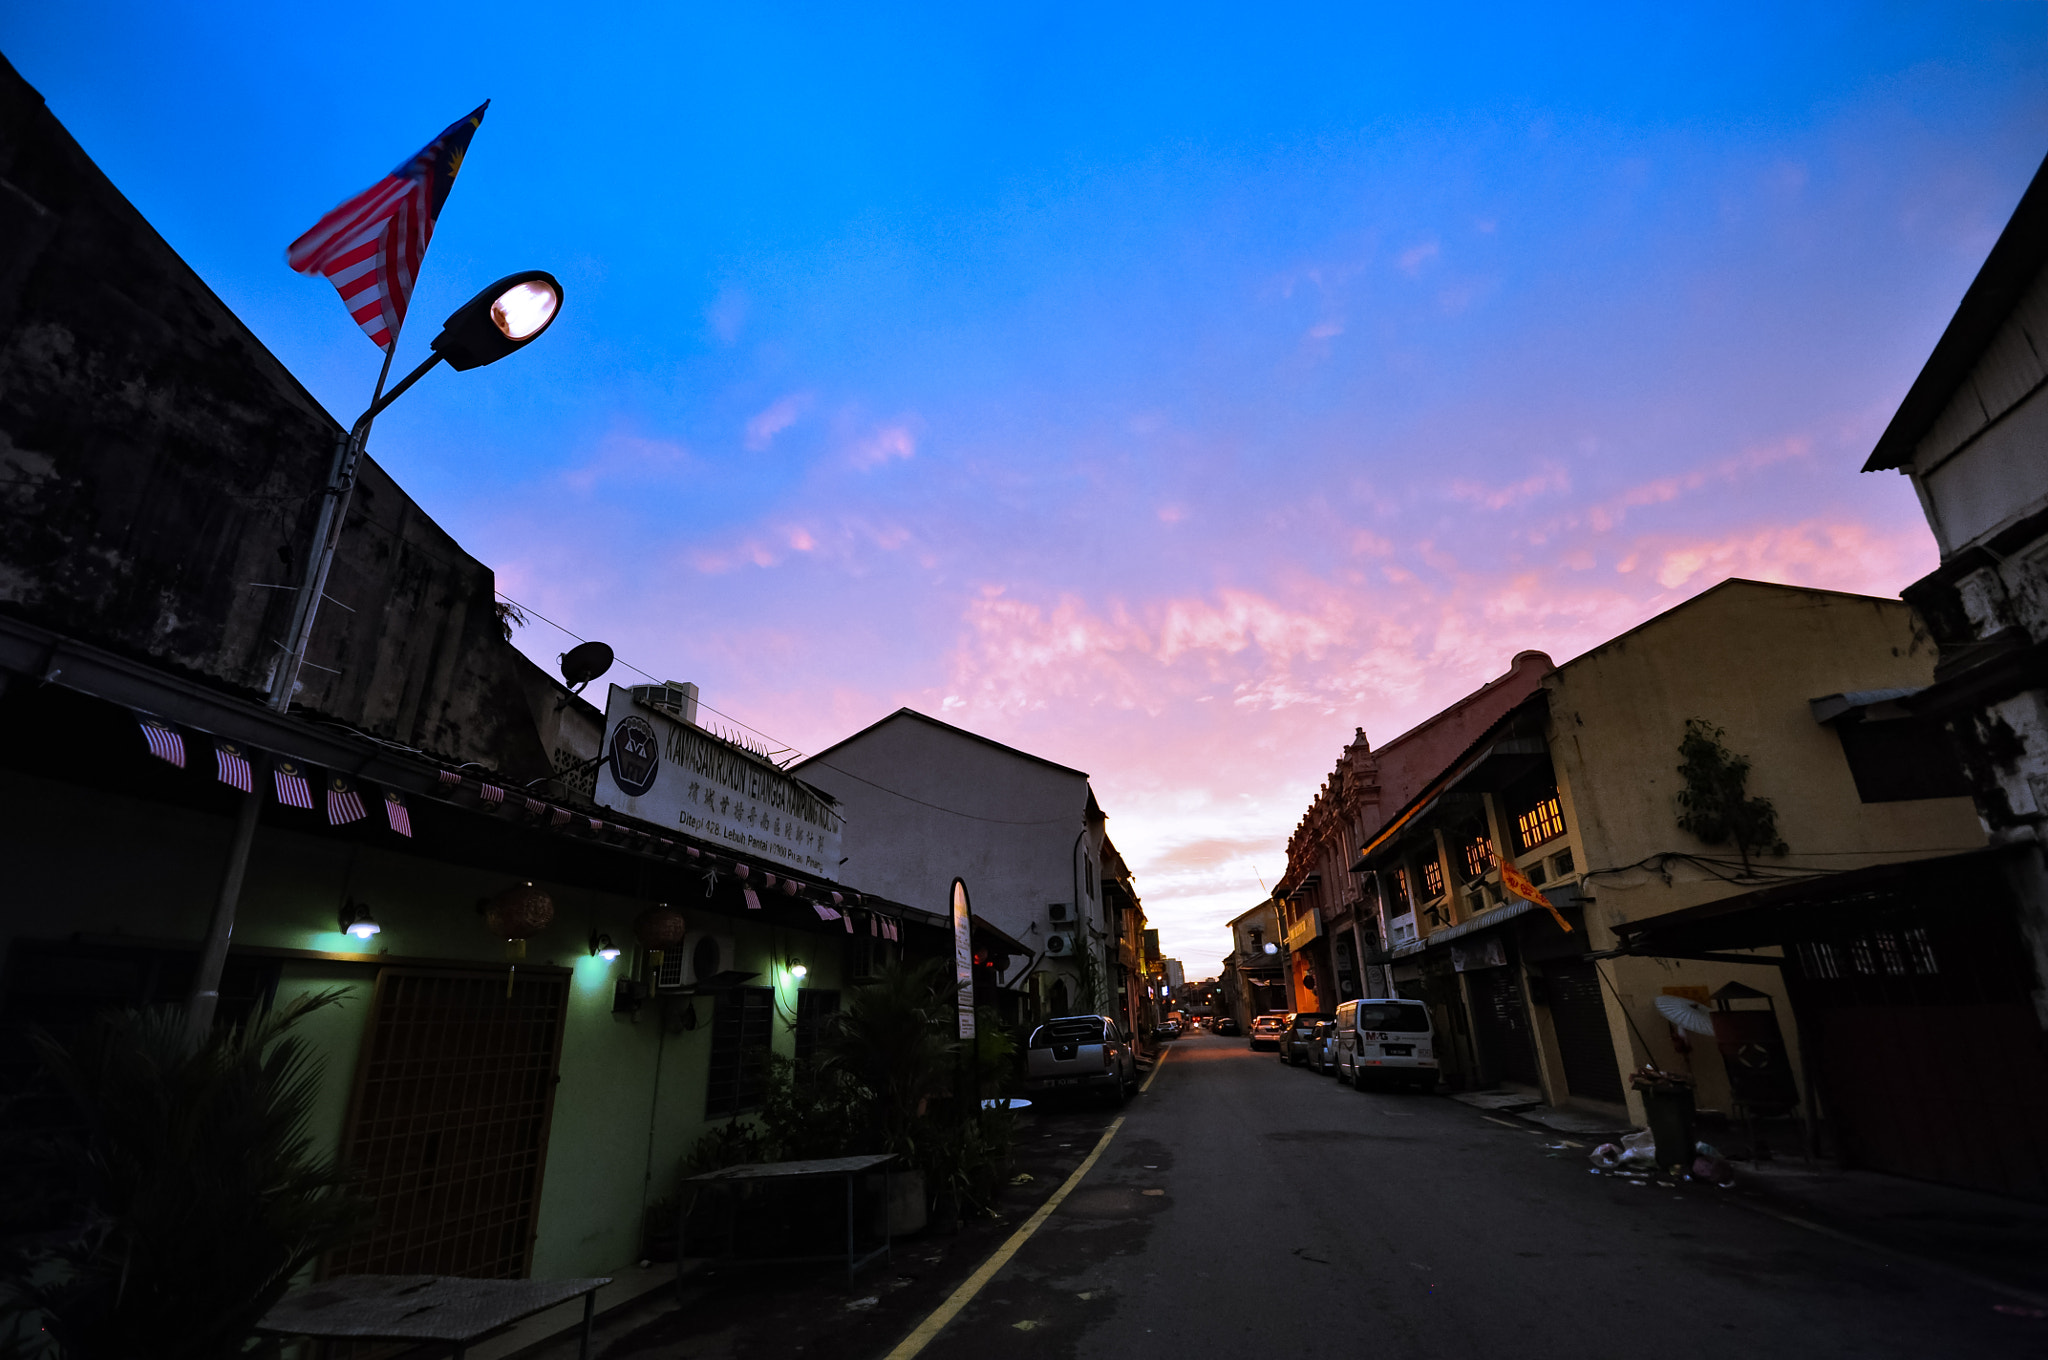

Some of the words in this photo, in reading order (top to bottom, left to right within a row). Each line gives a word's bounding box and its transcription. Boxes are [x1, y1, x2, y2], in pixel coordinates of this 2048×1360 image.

[665, 726, 715, 779] KAWASAN
[715, 750, 746, 793] RUKUN
[747, 765, 785, 812] TETANGGA
[723, 825, 746, 845] Lebuh
[747, 834, 768, 851] Pantai
